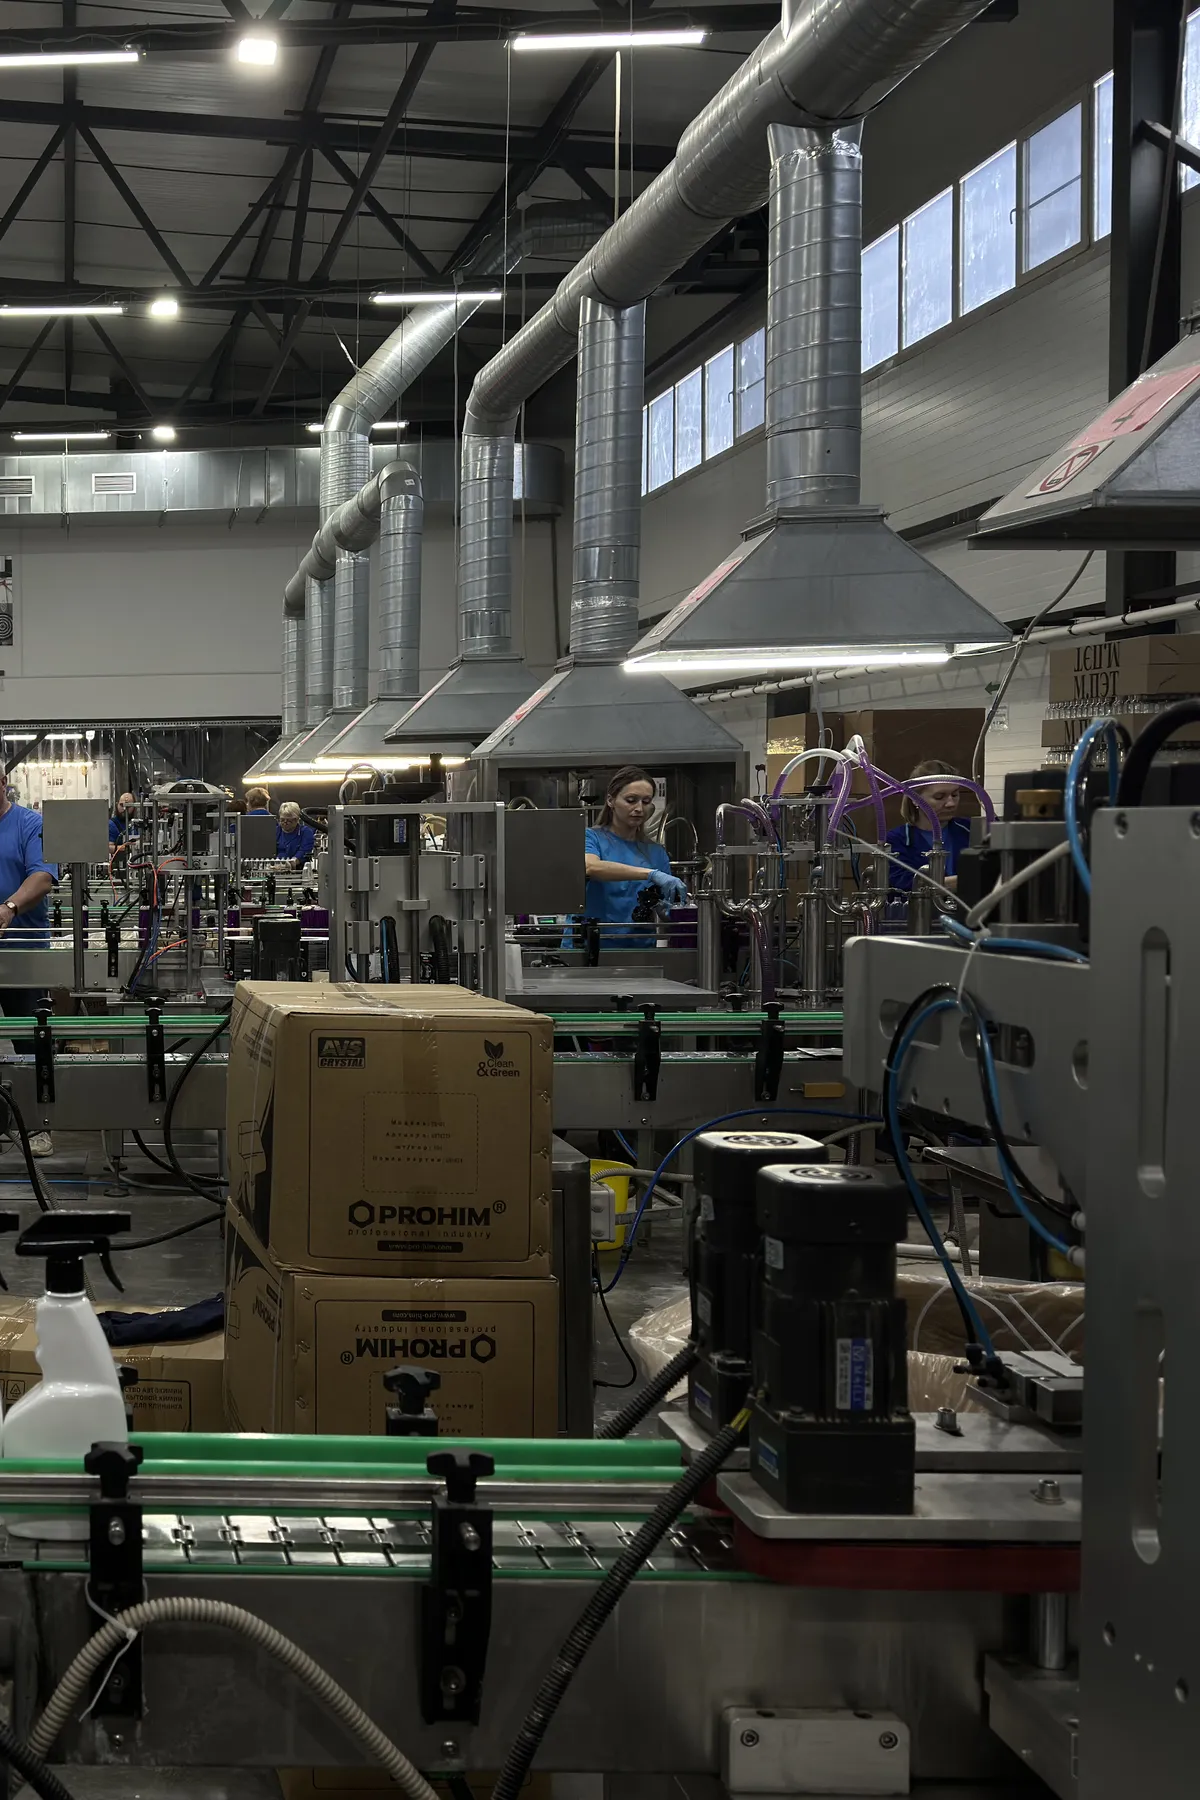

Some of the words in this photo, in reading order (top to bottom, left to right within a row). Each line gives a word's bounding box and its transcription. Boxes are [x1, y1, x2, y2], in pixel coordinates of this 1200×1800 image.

[319, 1039, 363, 1056] AVS
[319, 1058, 363, 1067] CRYSTAL
[487, 1058, 514, 1067] Clean
[490, 1068, 520, 1077] Green
[348, 1228, 430, 1236] professional
[438, 1230, 491, 1239] industry
[355, 1325, 407, 1333] industry
[415, 1325, 496, 1334] professional
